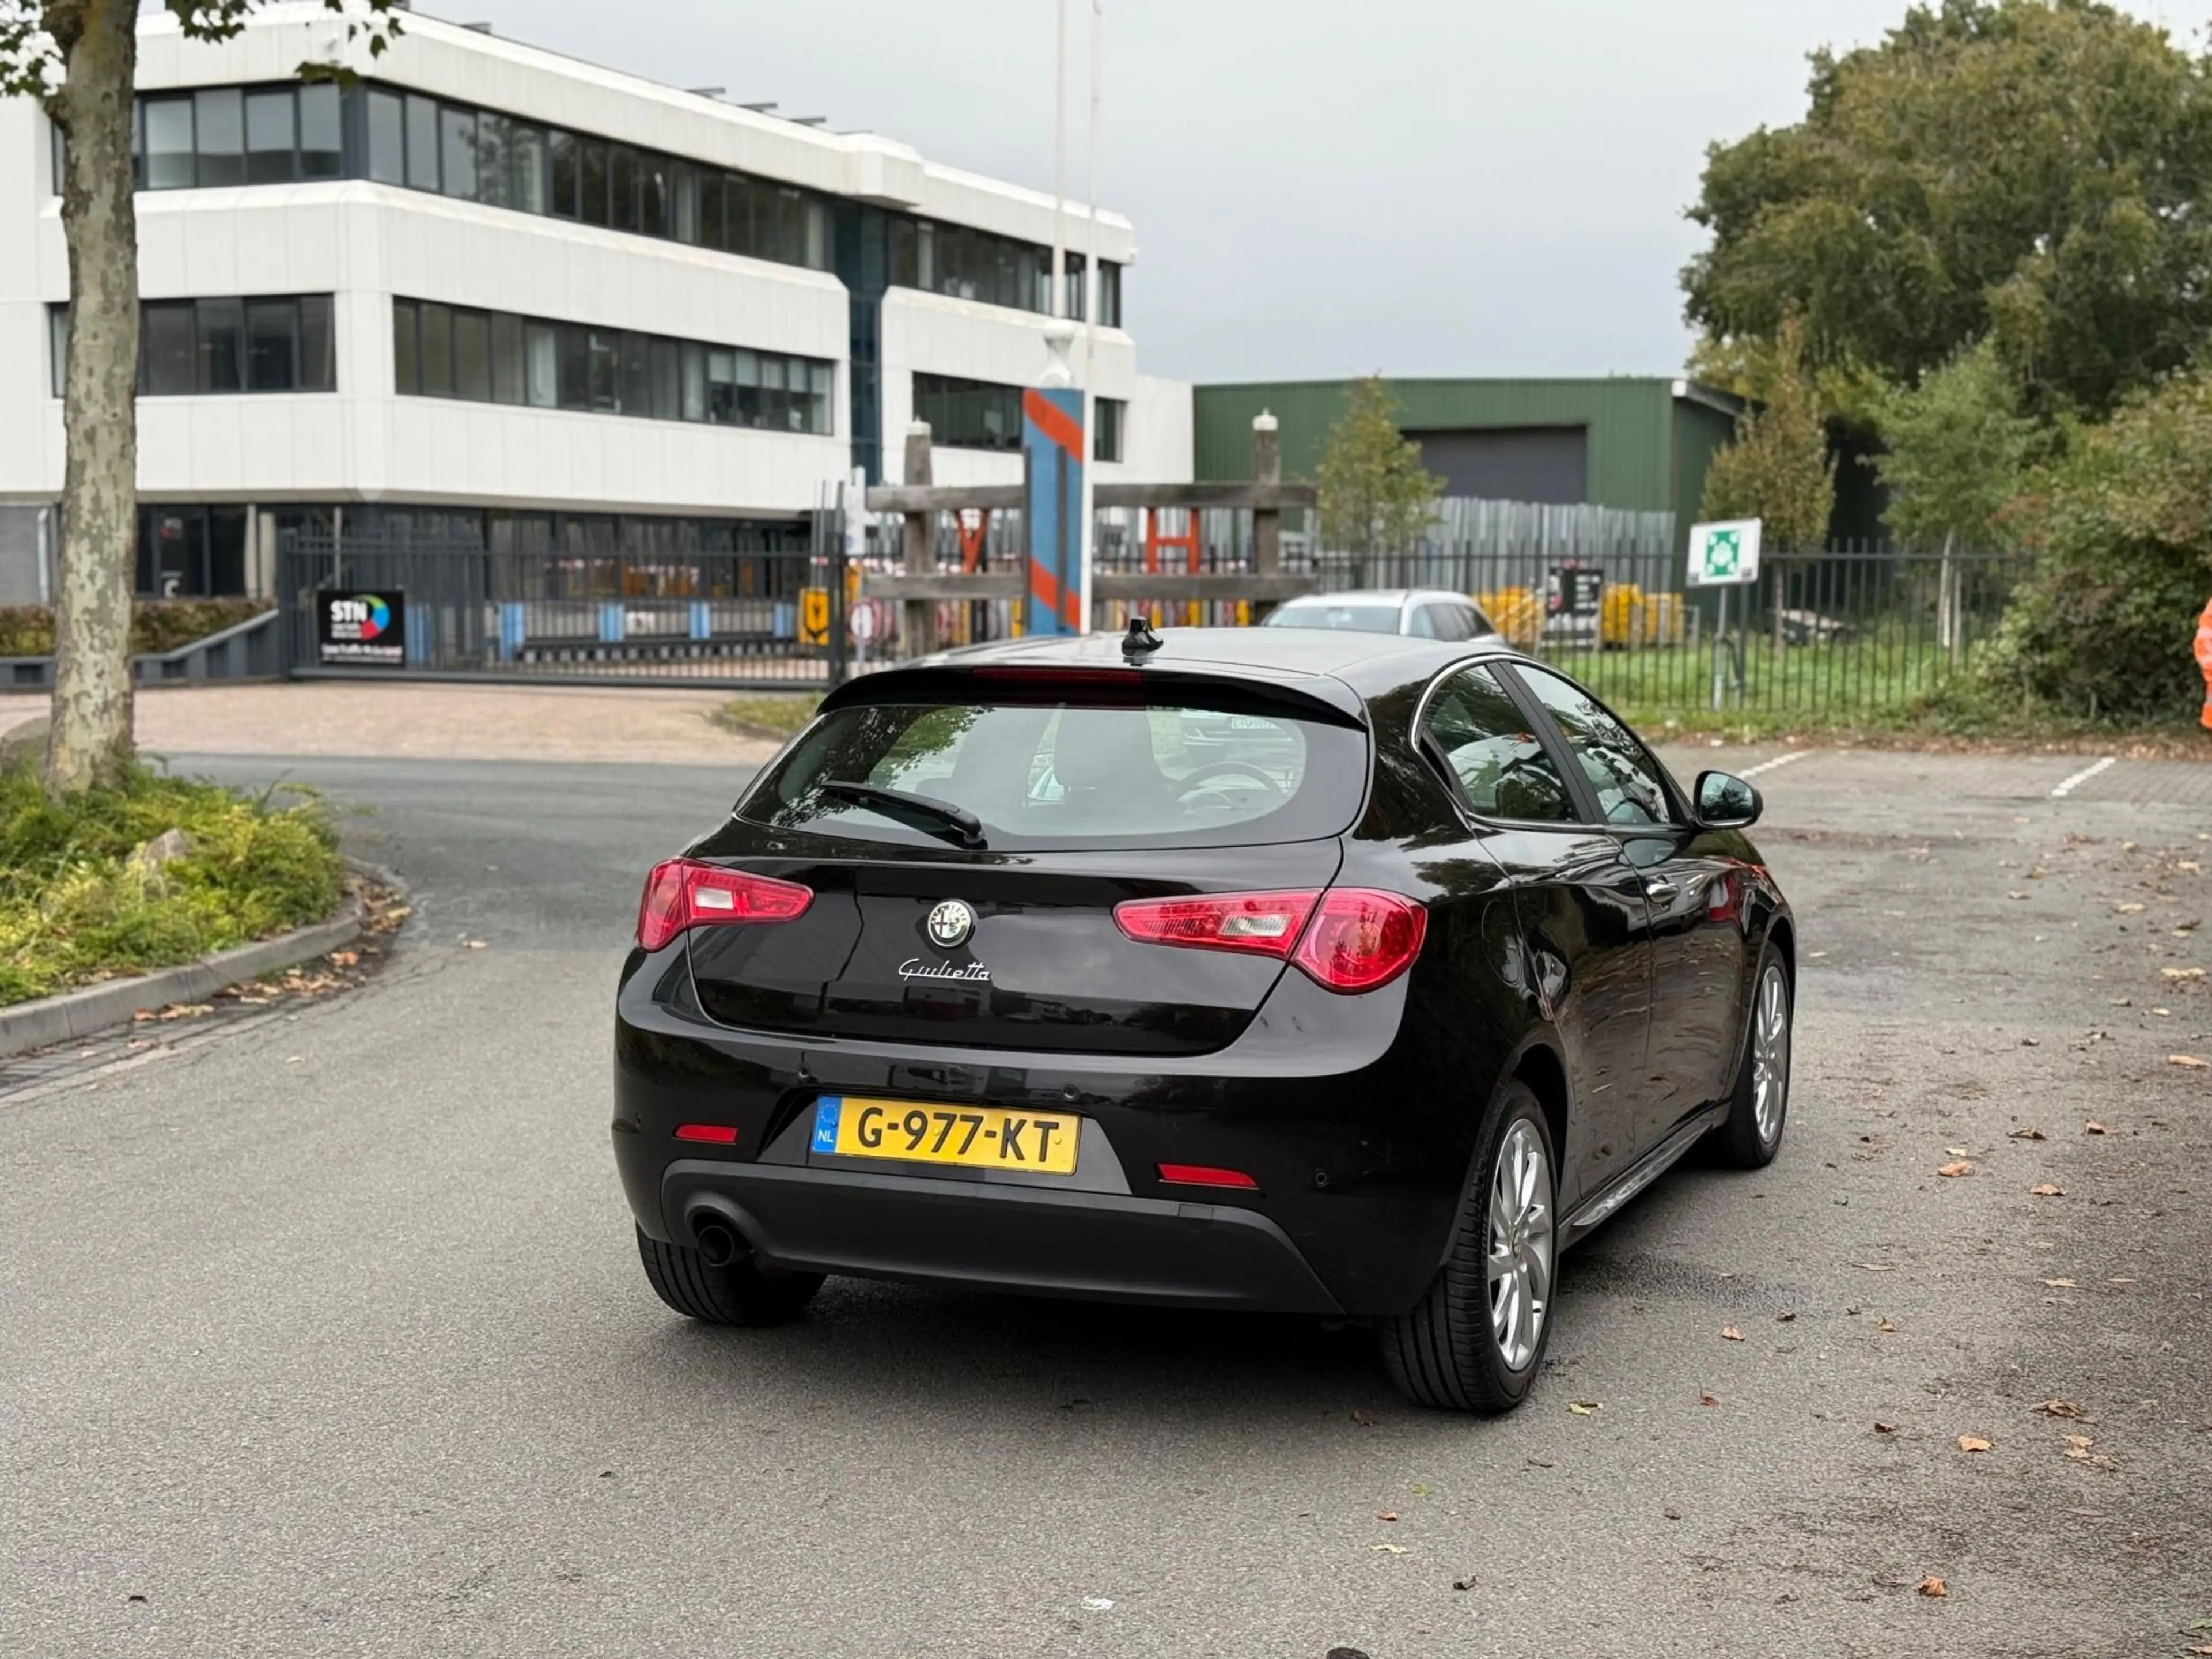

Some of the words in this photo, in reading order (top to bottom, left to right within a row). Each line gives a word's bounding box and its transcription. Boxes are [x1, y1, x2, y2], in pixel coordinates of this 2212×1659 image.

[331, 600, 368, 622] STN
[898, 957, 991, 982] Giulietta
[817, 1130, 834, 1143] NL
[857, 1107, 1060, 1162] G-977-KT
